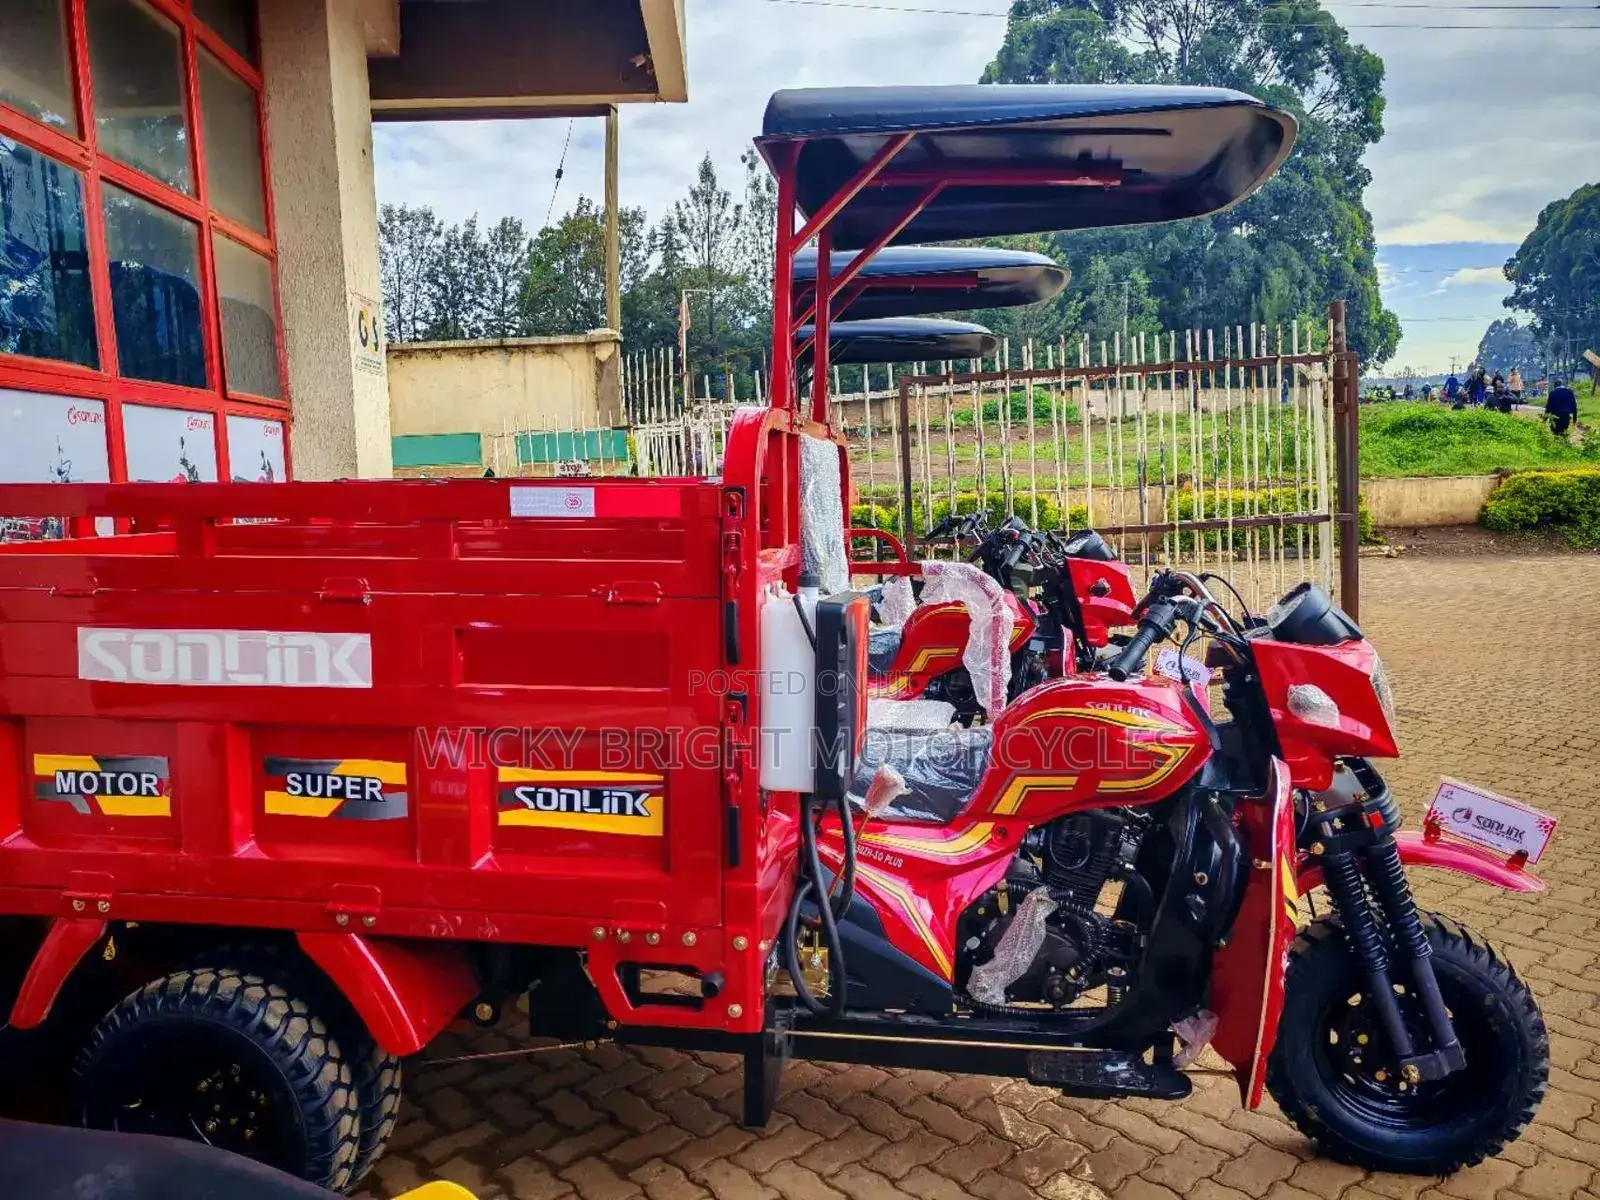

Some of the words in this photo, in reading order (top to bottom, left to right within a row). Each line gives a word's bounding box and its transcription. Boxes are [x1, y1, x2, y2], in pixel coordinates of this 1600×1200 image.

[85, 632, 371, 687] SONLINK
[55, 771, 160, 797] MOTOR
[286, 773, 384, 802] SUPER
[513, 786, 651, 817] SONLINK
[1475, 814, 1527, 841] SONLINK
[884, 853, 904, 868] PLUS
